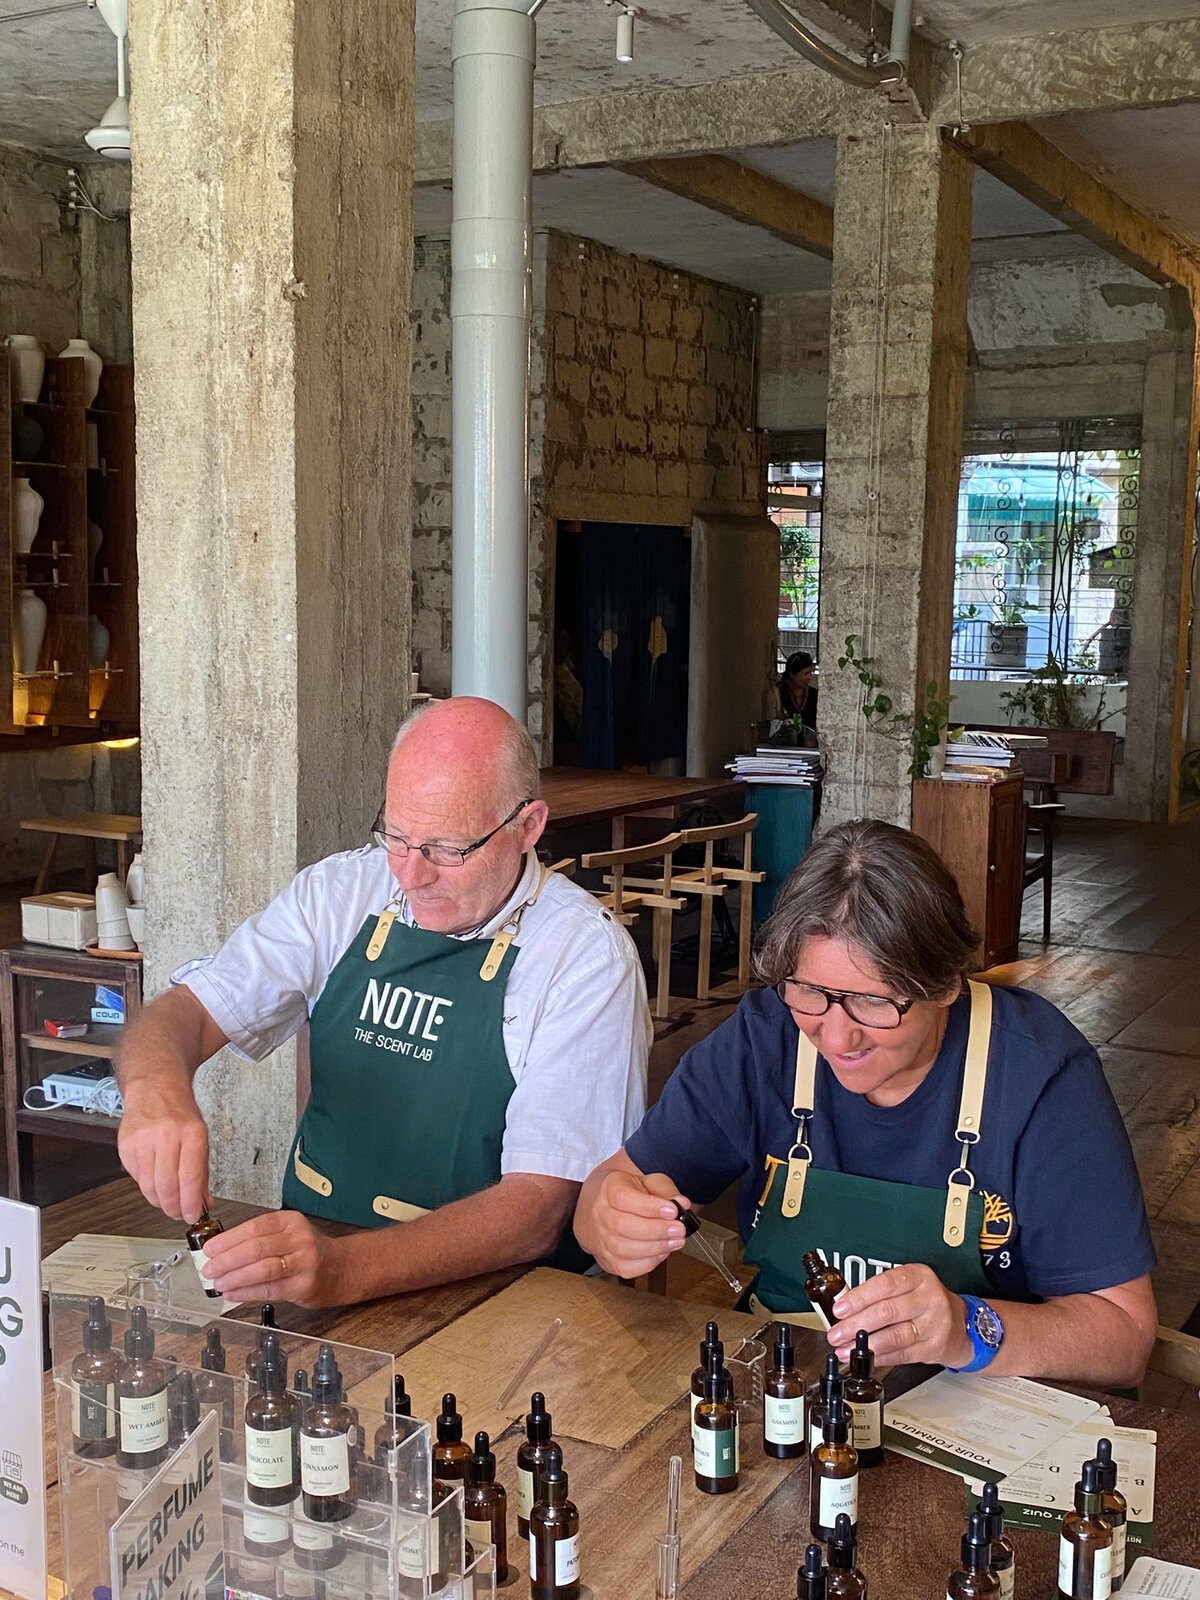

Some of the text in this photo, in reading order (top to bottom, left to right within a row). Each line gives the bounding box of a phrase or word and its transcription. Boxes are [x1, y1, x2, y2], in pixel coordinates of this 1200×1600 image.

[359, 978, 453, 1041] NOTE
[354, 1027, 433, 1062] THE SCENT LAB
[816, 1248, 904, 1290] NOT
[892, 1419, 954, 1450] FORMULA
[248, 1452, 285, 1465] CHOCOLATE
[303, 1461, 340, 1472] CINNAMON
[954, 1446, 992, 1465] YOUR
[122, 1446, 214, 1589] PERFUME
[1022, 1508, 1053, 1519] QUIZ
[11, 1543, 25, 1557] the
